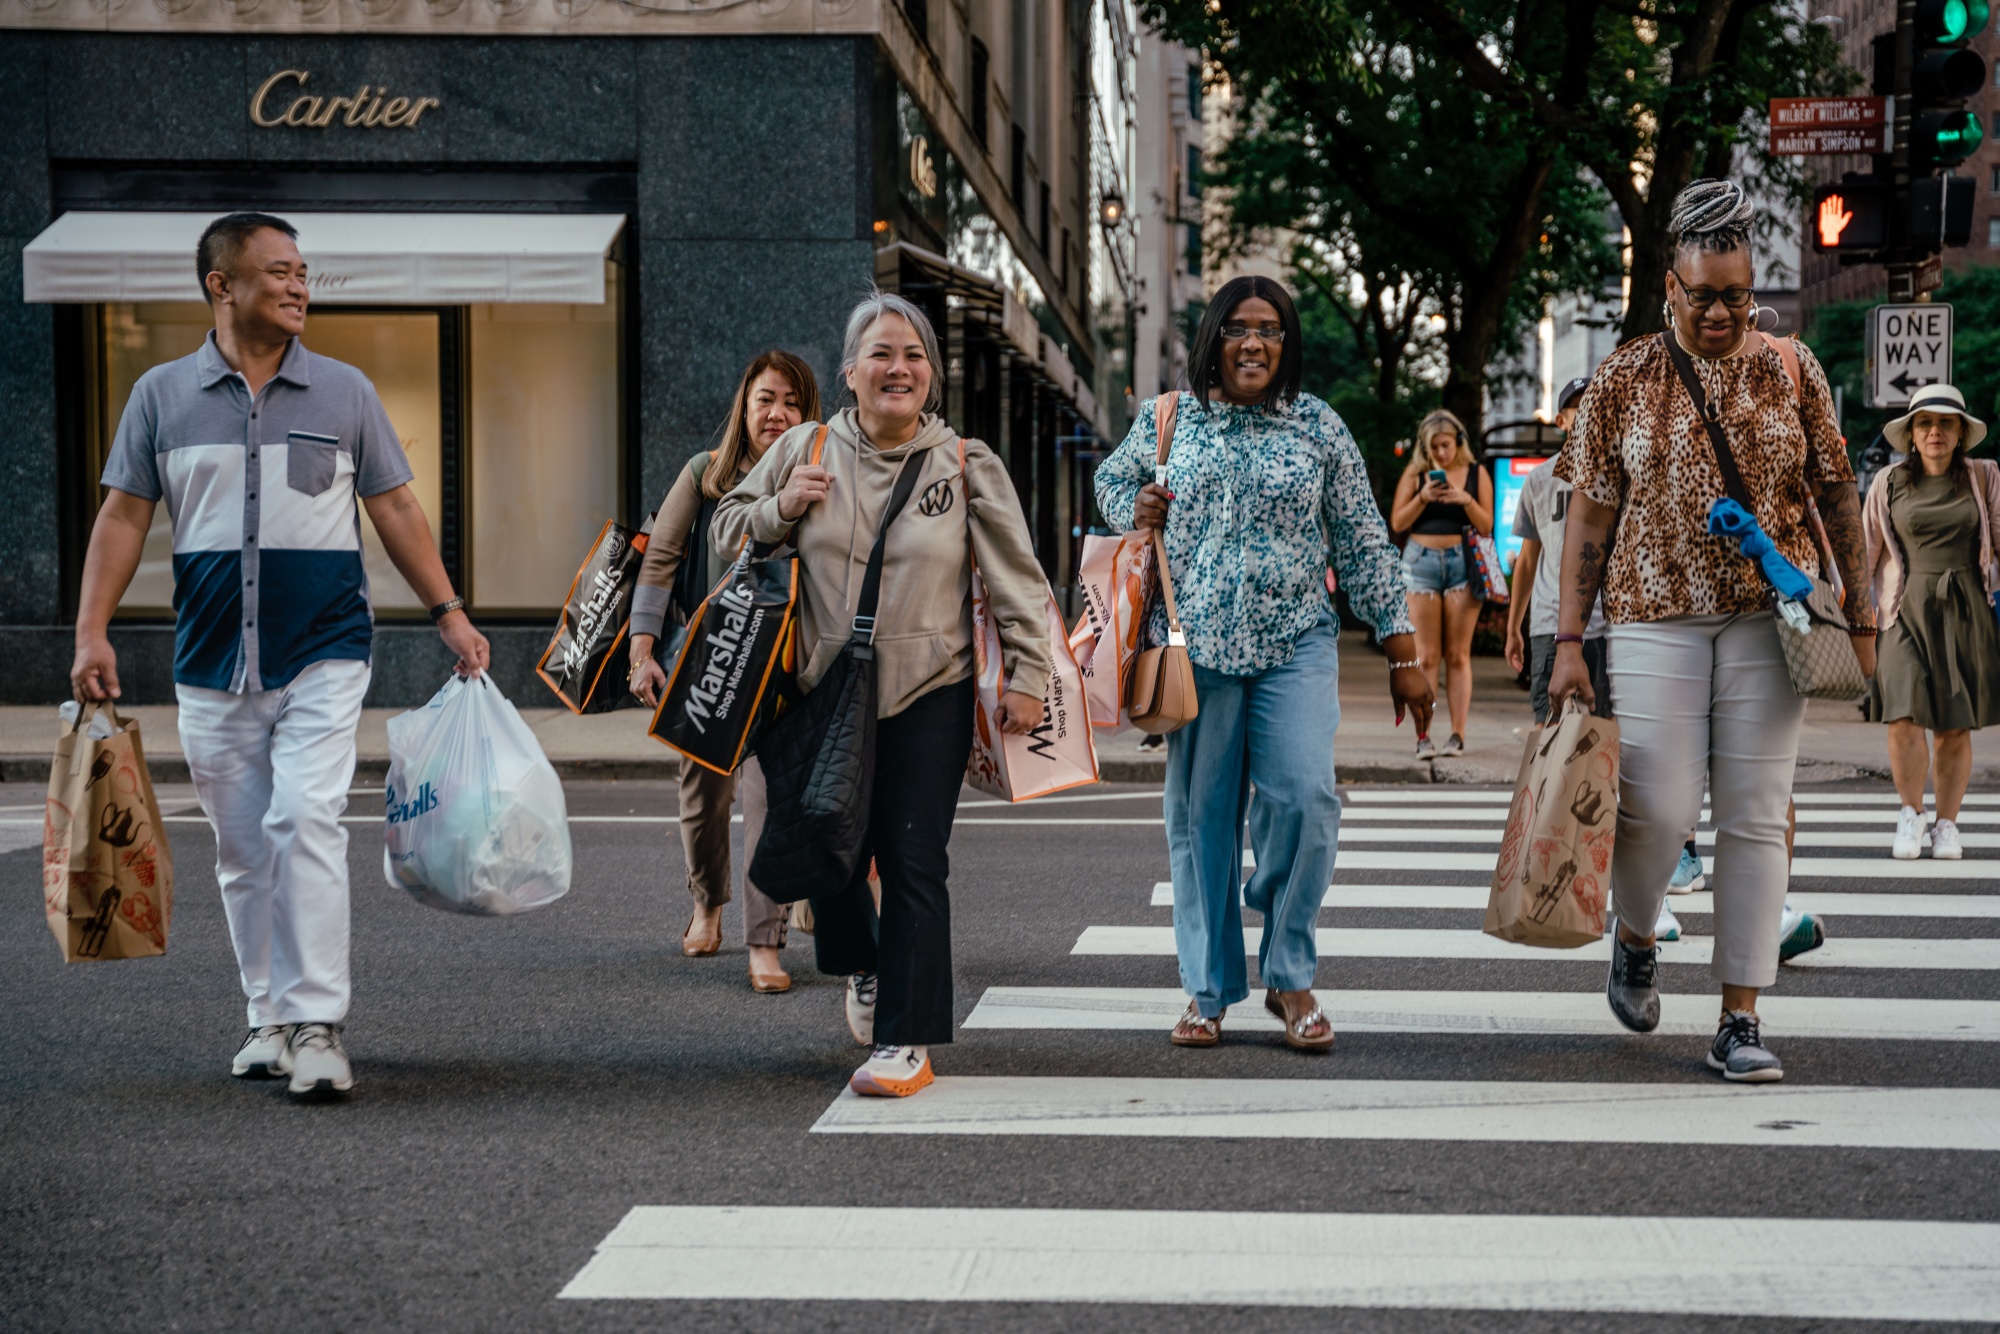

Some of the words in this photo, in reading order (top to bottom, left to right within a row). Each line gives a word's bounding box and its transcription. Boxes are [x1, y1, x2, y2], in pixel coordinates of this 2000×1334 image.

[250, 69, 440, 128] Cartier
[1809, 101, 1849, 109] HONORARY
[1778, 108, 1815, 123] WILBERT
[1819, 106, 1861, 121] WILLIAMS
[1863, 108, 1875, 118] WAY
[1777, 137, 1816, 152] MARILYN
[1821, 136, 1861, 152] SIMPSON
[1864, 138, 1876, 148] WAY
[306, 271, 354, 288] rtier
[1886, 313, 1941, 337] ONE
[1885, 341, 1943, 364] WAY
[564, 565, 624, 680] Marshalls
[585, 589, 624, 651] Marshalls.com
[685, 582, 754, 735] Marshalls
[715, 690, 736, 720] Shop
[726, 608, 765, 689] Marshalls.com
[1057, 708, 1067, 739] Shop
